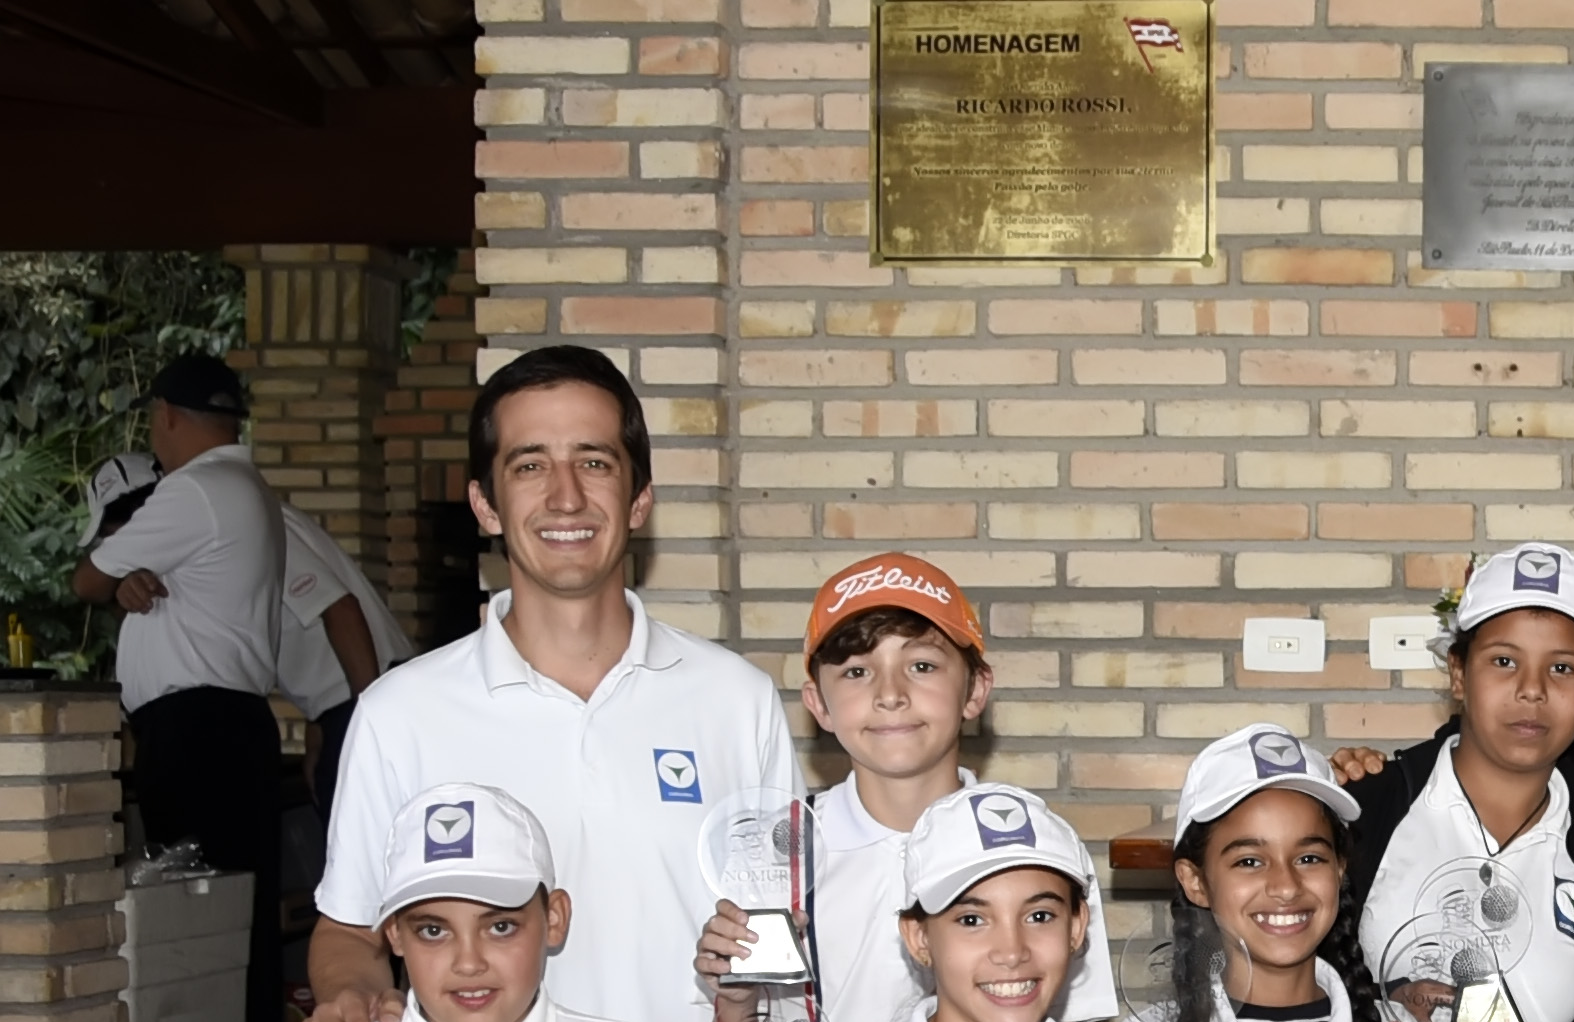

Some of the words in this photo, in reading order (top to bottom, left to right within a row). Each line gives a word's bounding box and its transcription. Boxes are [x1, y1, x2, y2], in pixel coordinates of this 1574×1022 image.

[915, 34, 1081, 54] HOMENAGEM
[956, 98, 1055, 115] RICARDO
[827, 565, 952, 613] Titleist
[725, 868, 790, 884] NOMUR
[1443, 933, 1511, 953] NOMURA
